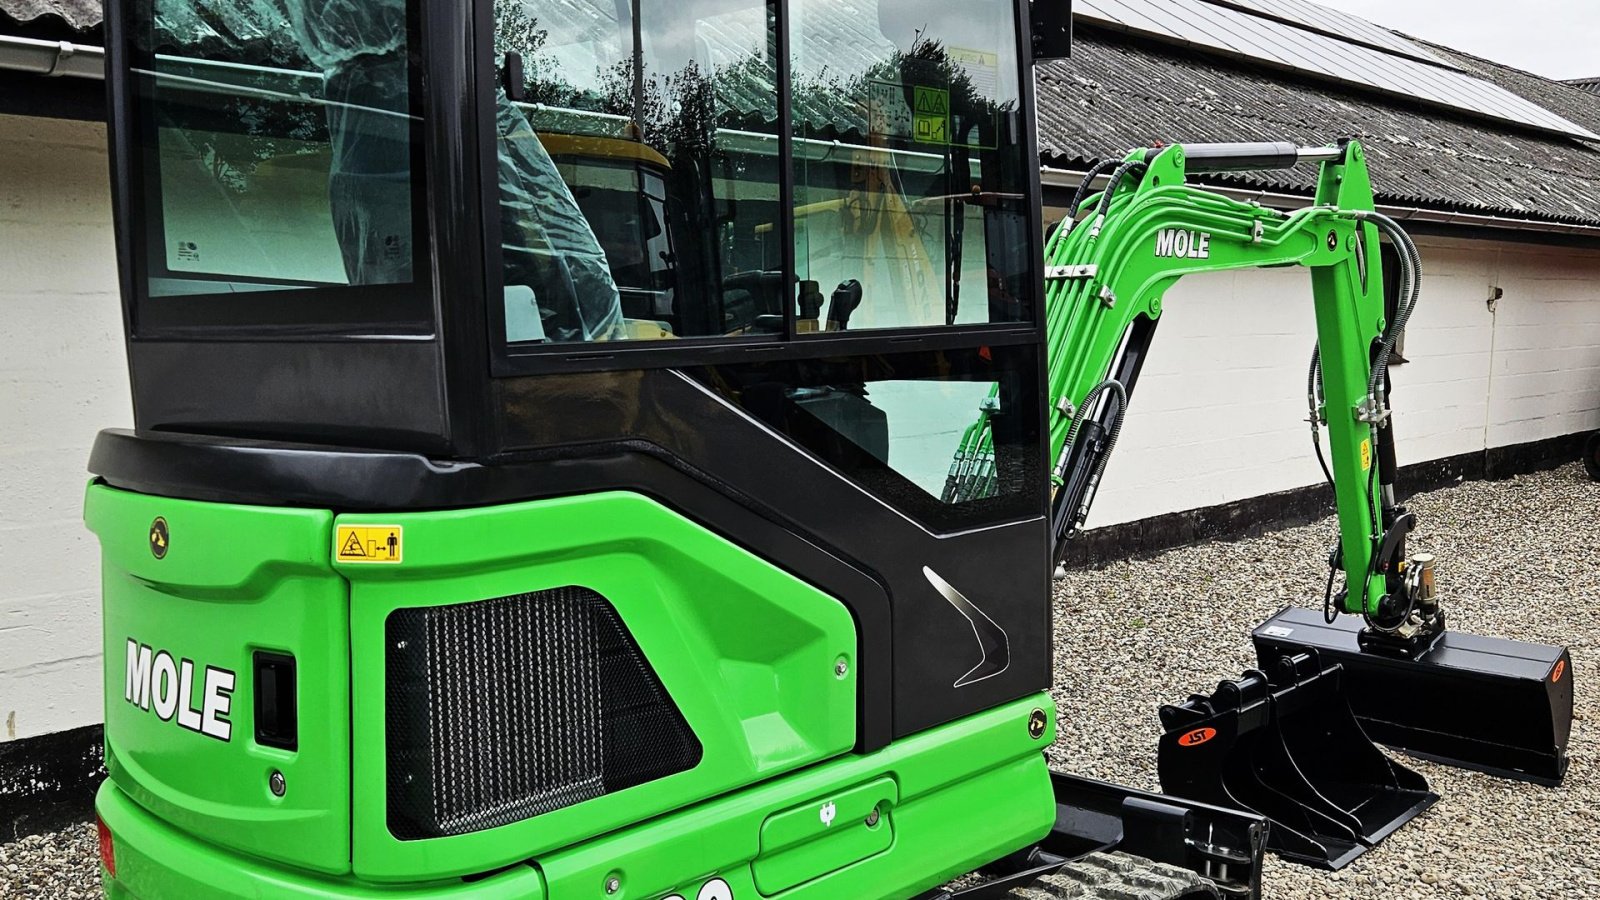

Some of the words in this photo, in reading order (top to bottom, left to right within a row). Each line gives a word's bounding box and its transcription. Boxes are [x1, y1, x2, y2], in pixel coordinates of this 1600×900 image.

[1155, 228, 1211, 259] MOLE
[125, 636, 236, 743] MOLE
[1188, 729, 1207, 744] JST
